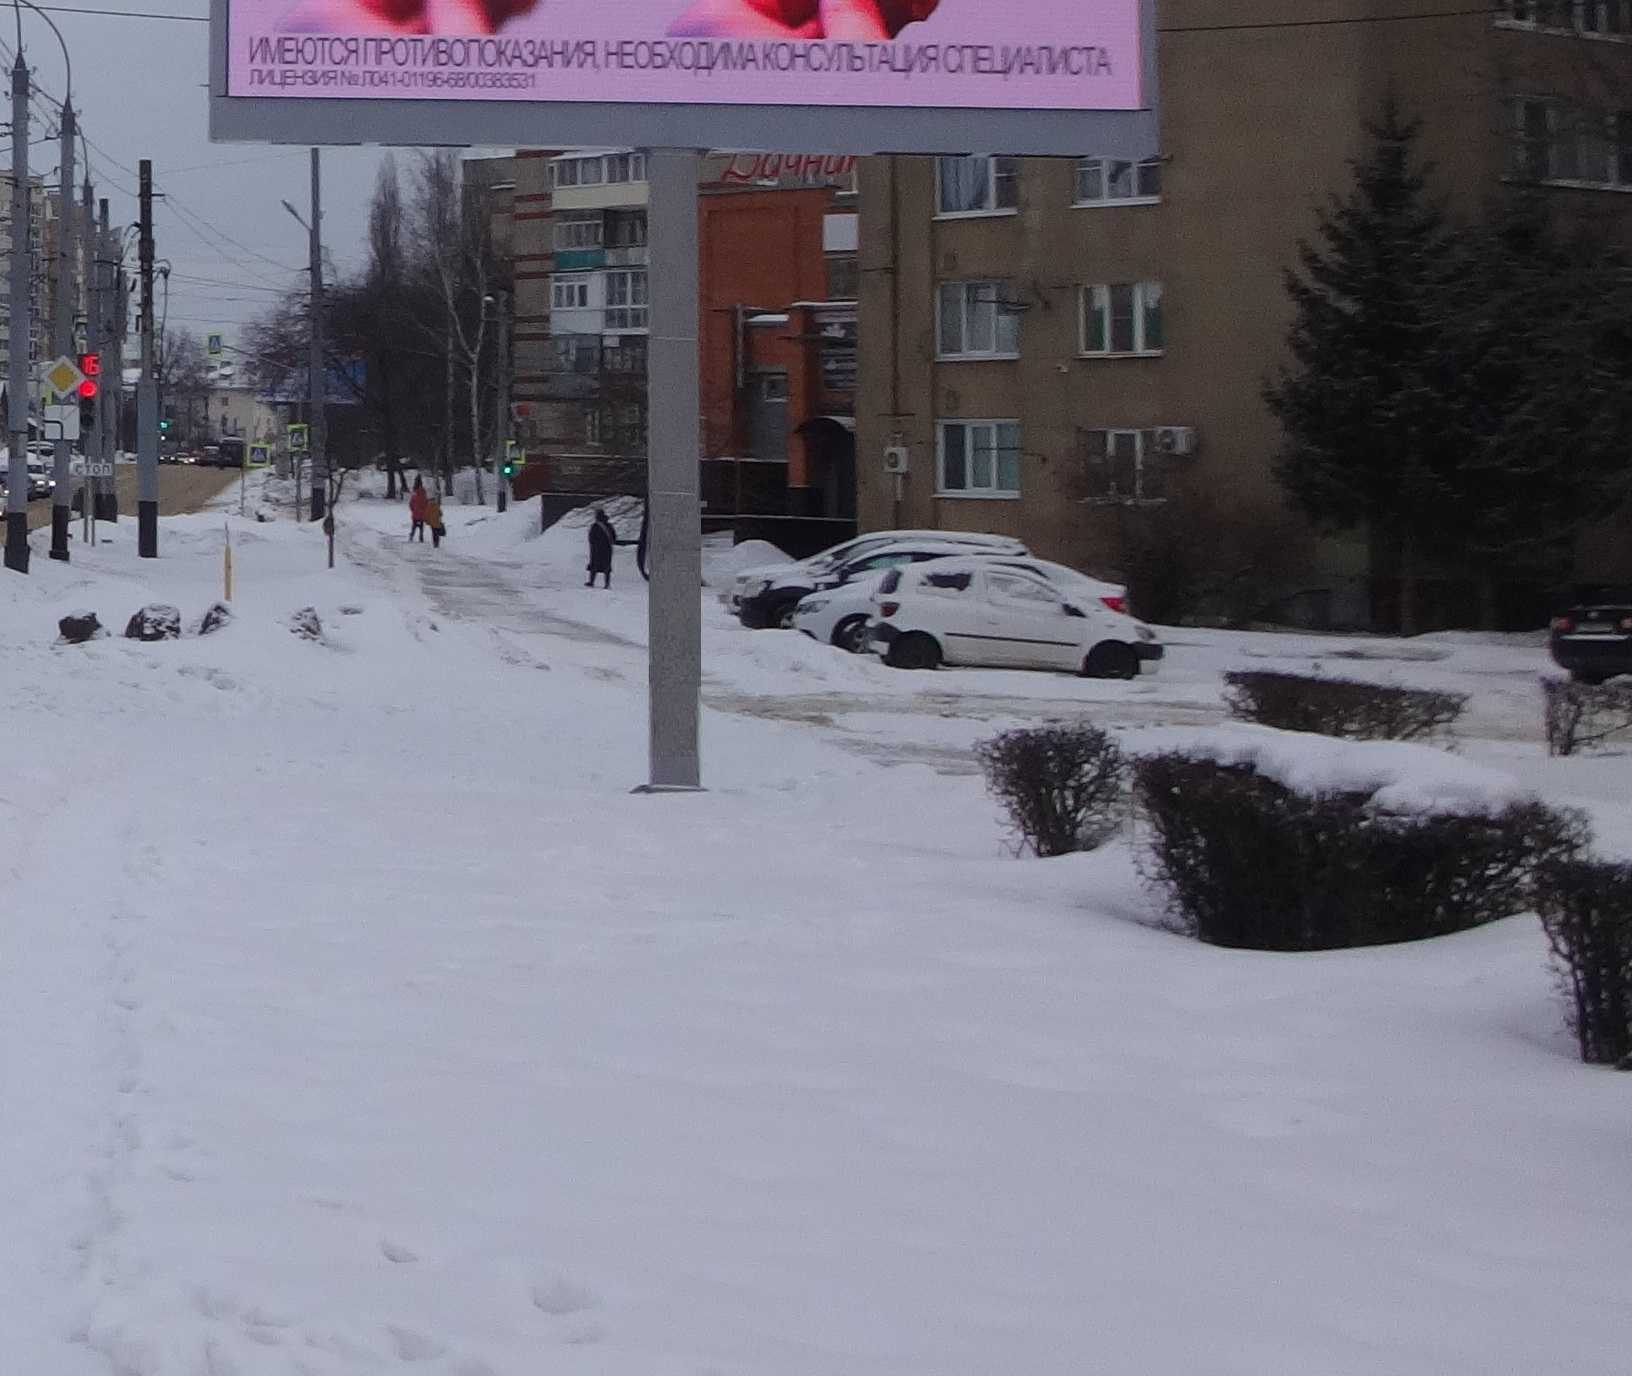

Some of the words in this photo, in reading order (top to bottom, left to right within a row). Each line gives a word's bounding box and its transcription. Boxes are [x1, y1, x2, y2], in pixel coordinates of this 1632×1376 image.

[249, 36, 359, 66] ИМЕЮТСЯ
[363, 38, 599, 71] ПРОТИВОПОКАЗАНИЯ,
[606, 40, 756, 75] НЕОБХОДИМА
[762, 42, 938, 79] КОНСУЛЬТАЦИЯ
[943, 44, 1113, 80] СПЕЦИАЛИСТА
[249, 68, 337, 88] ЛИЦЕНЗИЯ
